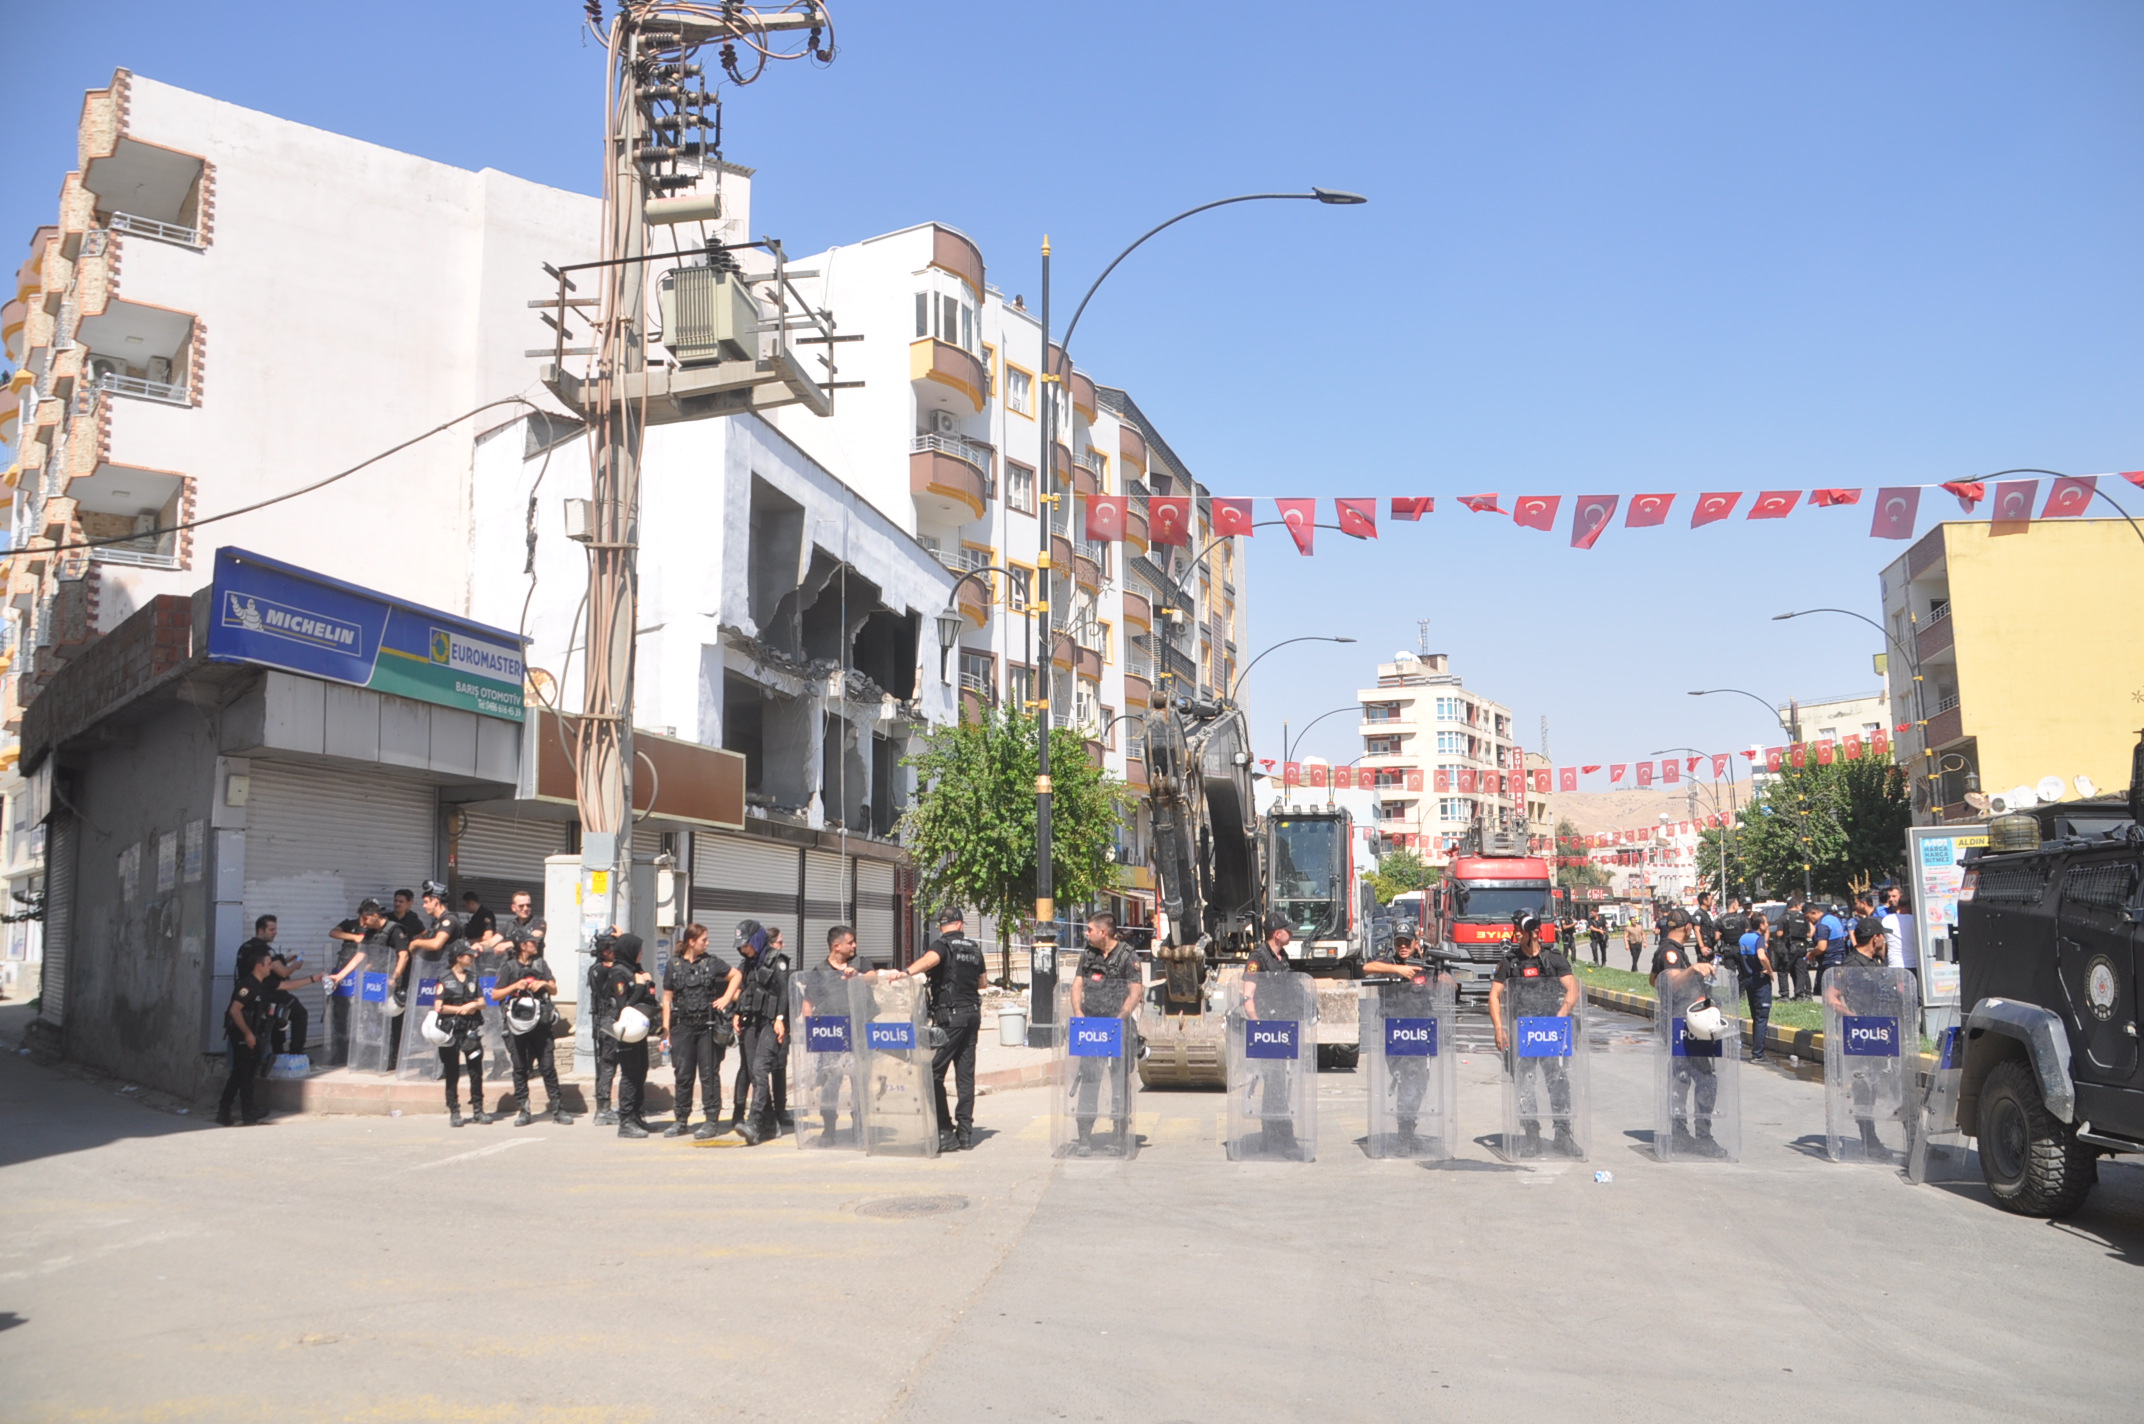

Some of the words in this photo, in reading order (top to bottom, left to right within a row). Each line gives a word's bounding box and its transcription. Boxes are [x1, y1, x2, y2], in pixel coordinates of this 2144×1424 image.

[265, 608, 355, 645] MICHELIN
[451, 642, 521, 677] EUROMASTER
[455, 681, 479, 698] BARIŞ
[480, 687, 521, 706] OTOMOTİV
[1958, 838, 1985, 846] ALDIN
[366, 982, 382, 992] POLİS
[421, 985, 437, 996] POLİ
[812, 1025, 843, 1038] POLİS
[872, 1028, 908, 1042] POLİS
[1078, 1031, 1108, 1042] POLİS
[1254, 1030, 1289, 1043] POLİS
[1393, 1028, 1428, 1041] POLİS
[1527, 1031, 1558, 1042] POLİS
[1851, 1027, 1889, 1040] POLİS
